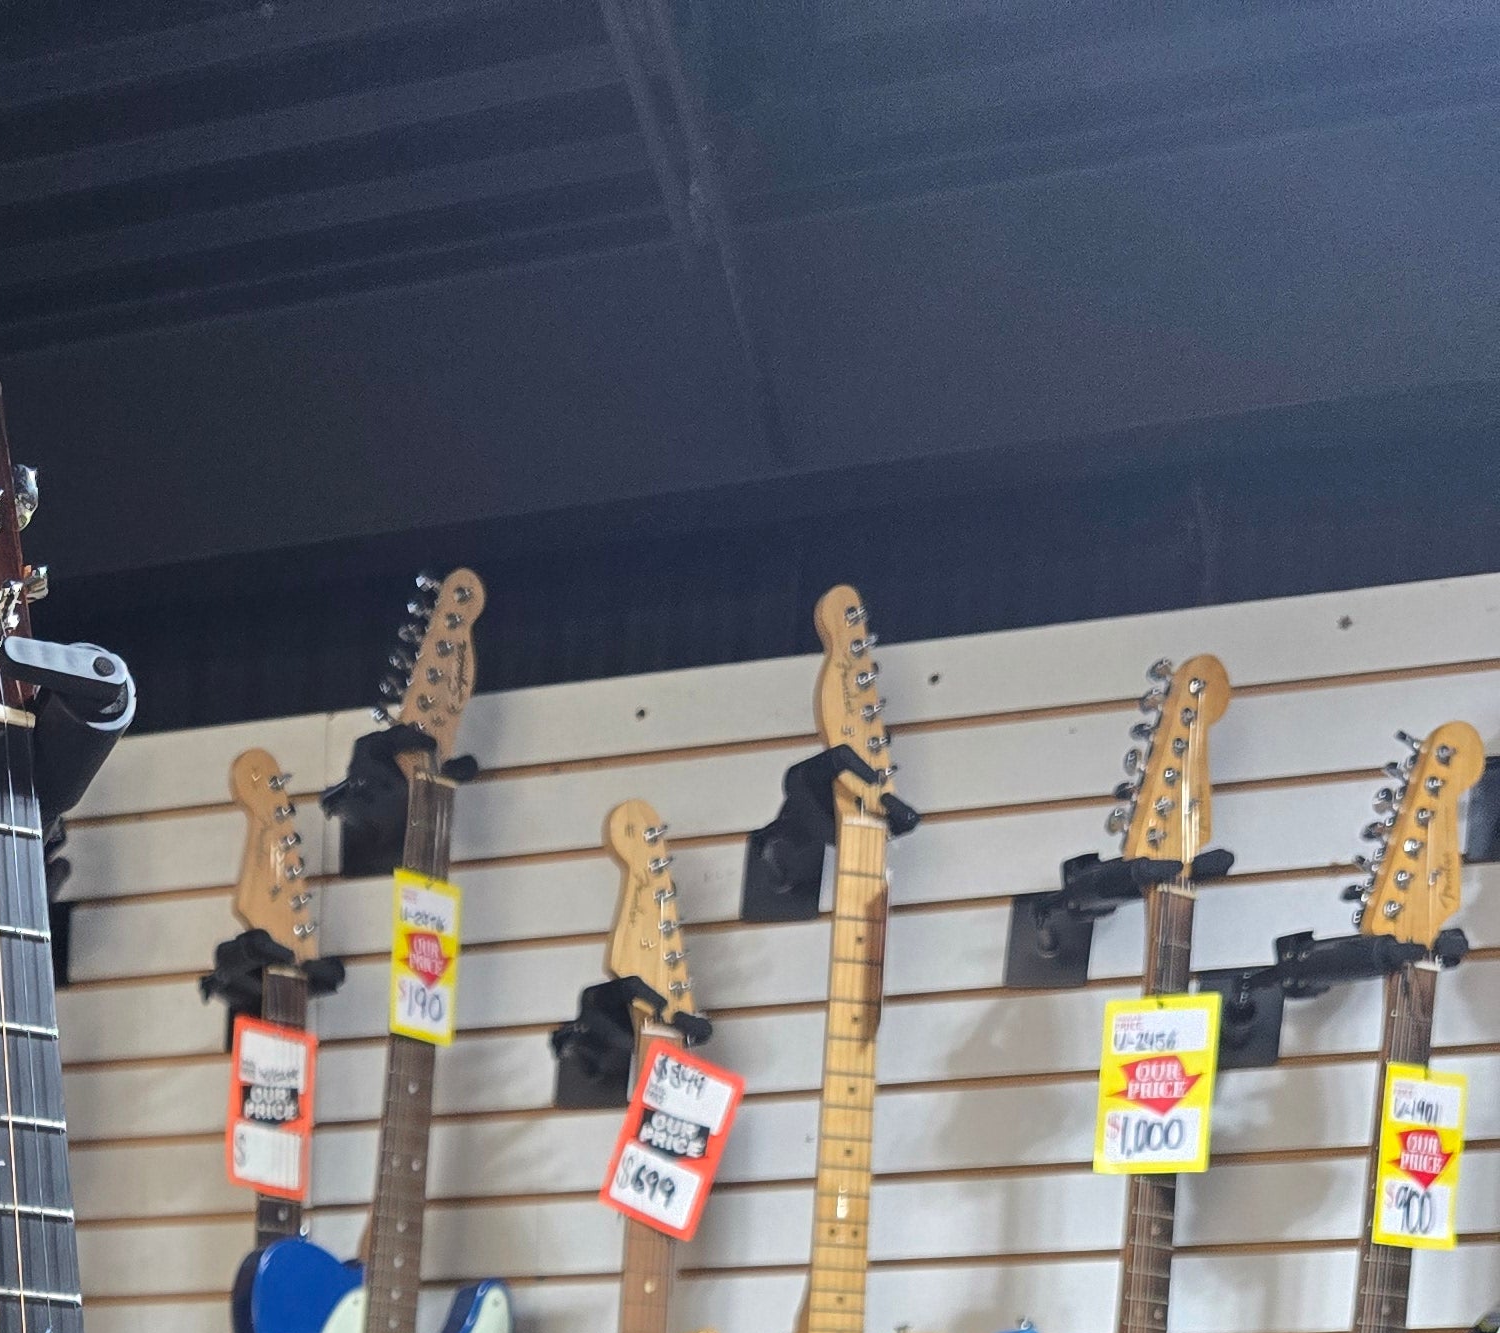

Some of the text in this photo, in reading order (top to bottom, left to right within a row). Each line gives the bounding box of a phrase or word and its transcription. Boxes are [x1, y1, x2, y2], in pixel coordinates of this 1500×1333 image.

[1135, 1060, 1183, 1082] OUR
[1127, 1080, 1188, 1100] PRICE
[651, 1111, 701, 1139] OUR
[638, 1122, 706, 1158] PRICE
[1405, 1131, 1441, 1154] OUR
[1399, 1151, 1444, 1175] PRICE
[616, 1155, 676, 1208] $699
